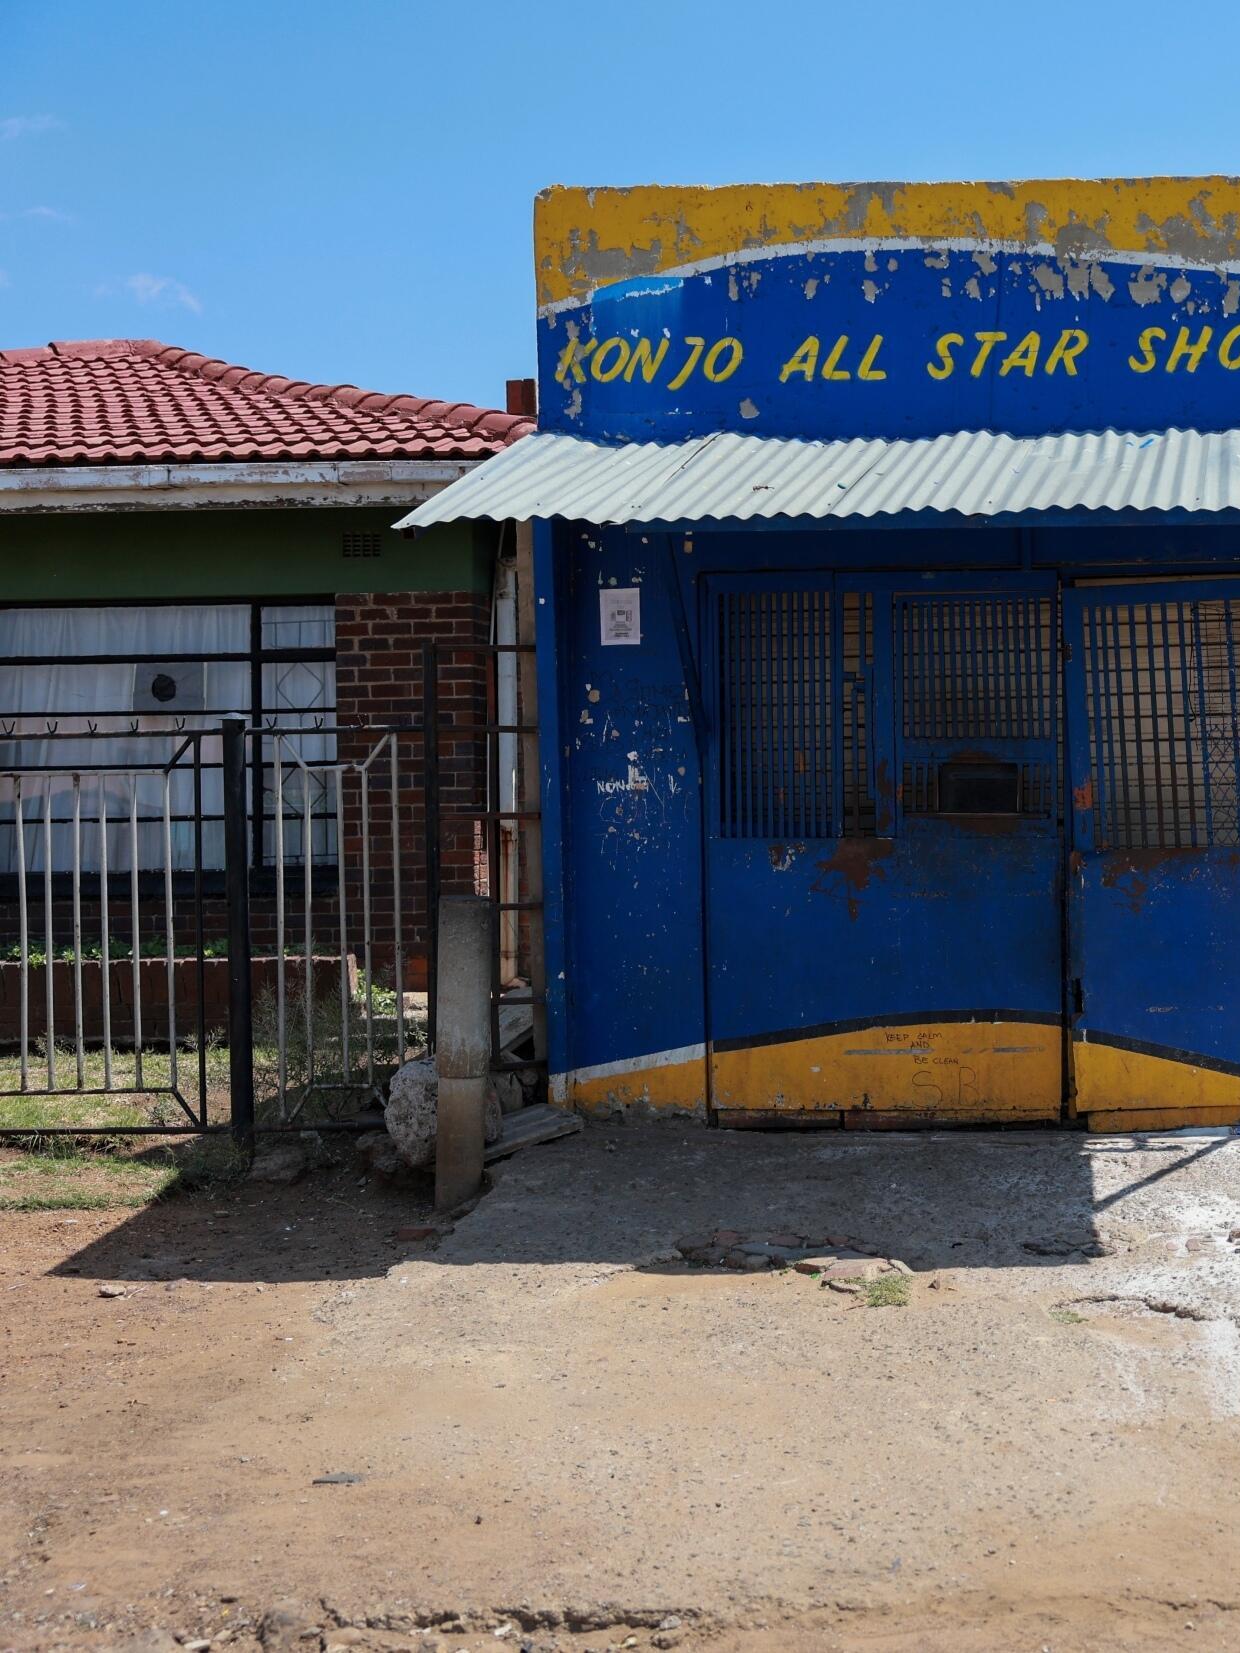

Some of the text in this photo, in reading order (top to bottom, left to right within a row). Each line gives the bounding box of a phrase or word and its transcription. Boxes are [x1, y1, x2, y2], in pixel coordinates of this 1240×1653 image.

[778, 333, 888, 383] ALL
[926, 328, 1090, 381] STAR
[884, 1031, 944, 1044] KEEP CALM
[910, 1040, 930, 1050] AND
[912, 1054, 930, 1065] BE
